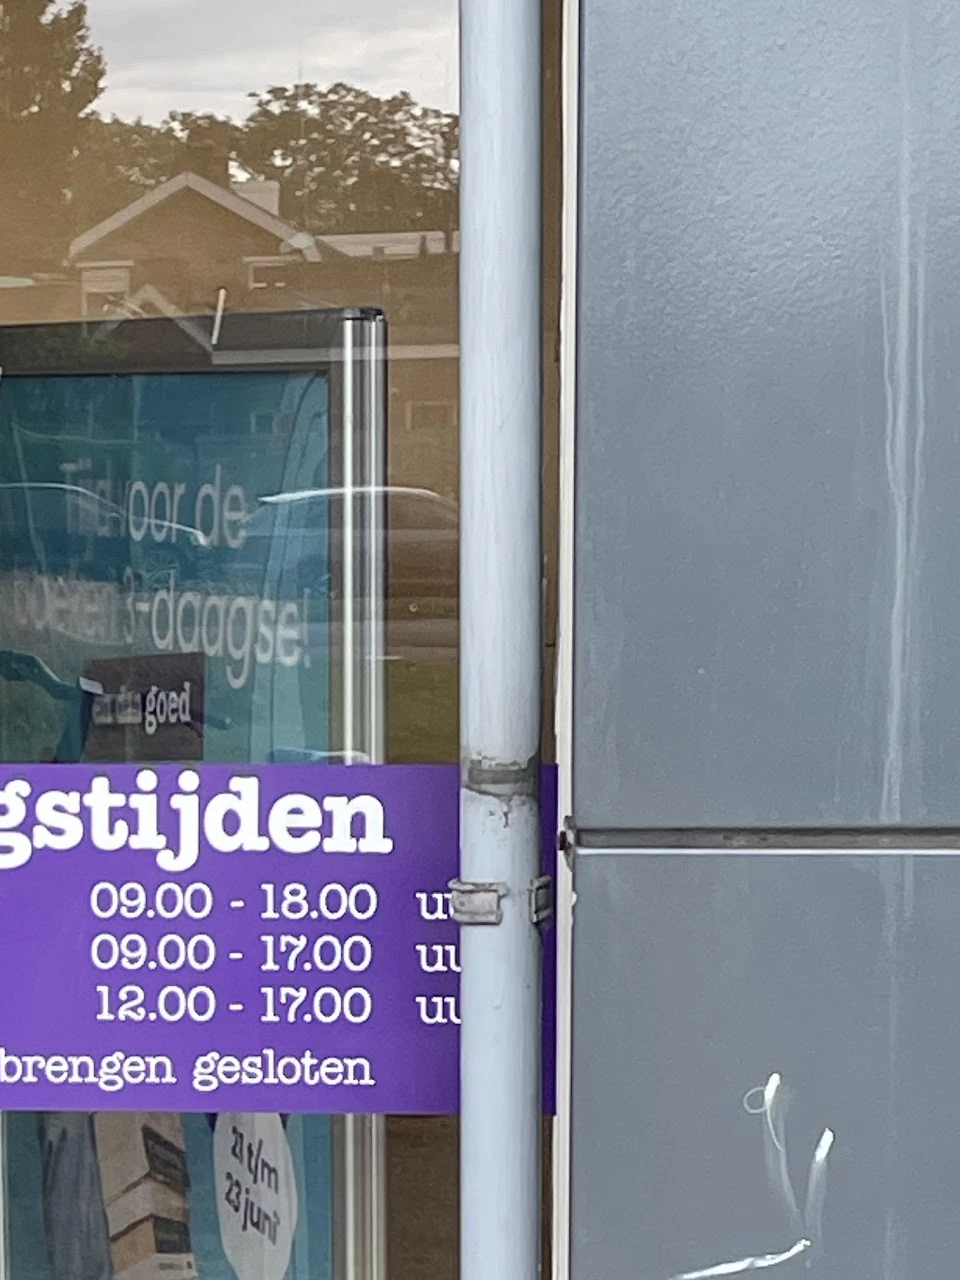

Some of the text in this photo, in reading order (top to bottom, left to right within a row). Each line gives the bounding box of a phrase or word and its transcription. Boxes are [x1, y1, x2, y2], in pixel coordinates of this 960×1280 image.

[195, 463, 248, 549] de
[145, 681, 191, 735] goed
[90, 881, 213, 920] 09.00
[229, 900, 245, 908] -
[260, 882, 378, 920] 18.00
[90, 933, 216, 971] 09.00
[260, 934, 372, 972] 17.00
[415, 944, 462, 972] uu
[96, 984, 216, 1022] 12.00
[260, 986, 372, 1023] 17.00
[415, 996, 462, 1024] uu
[192, 1048, 376, 1092] gesloten
[231, 1125, 244, 1164] 21
[247, 1138, 279, 1194] t/m
[225, 1172, 241, 1213] 23
